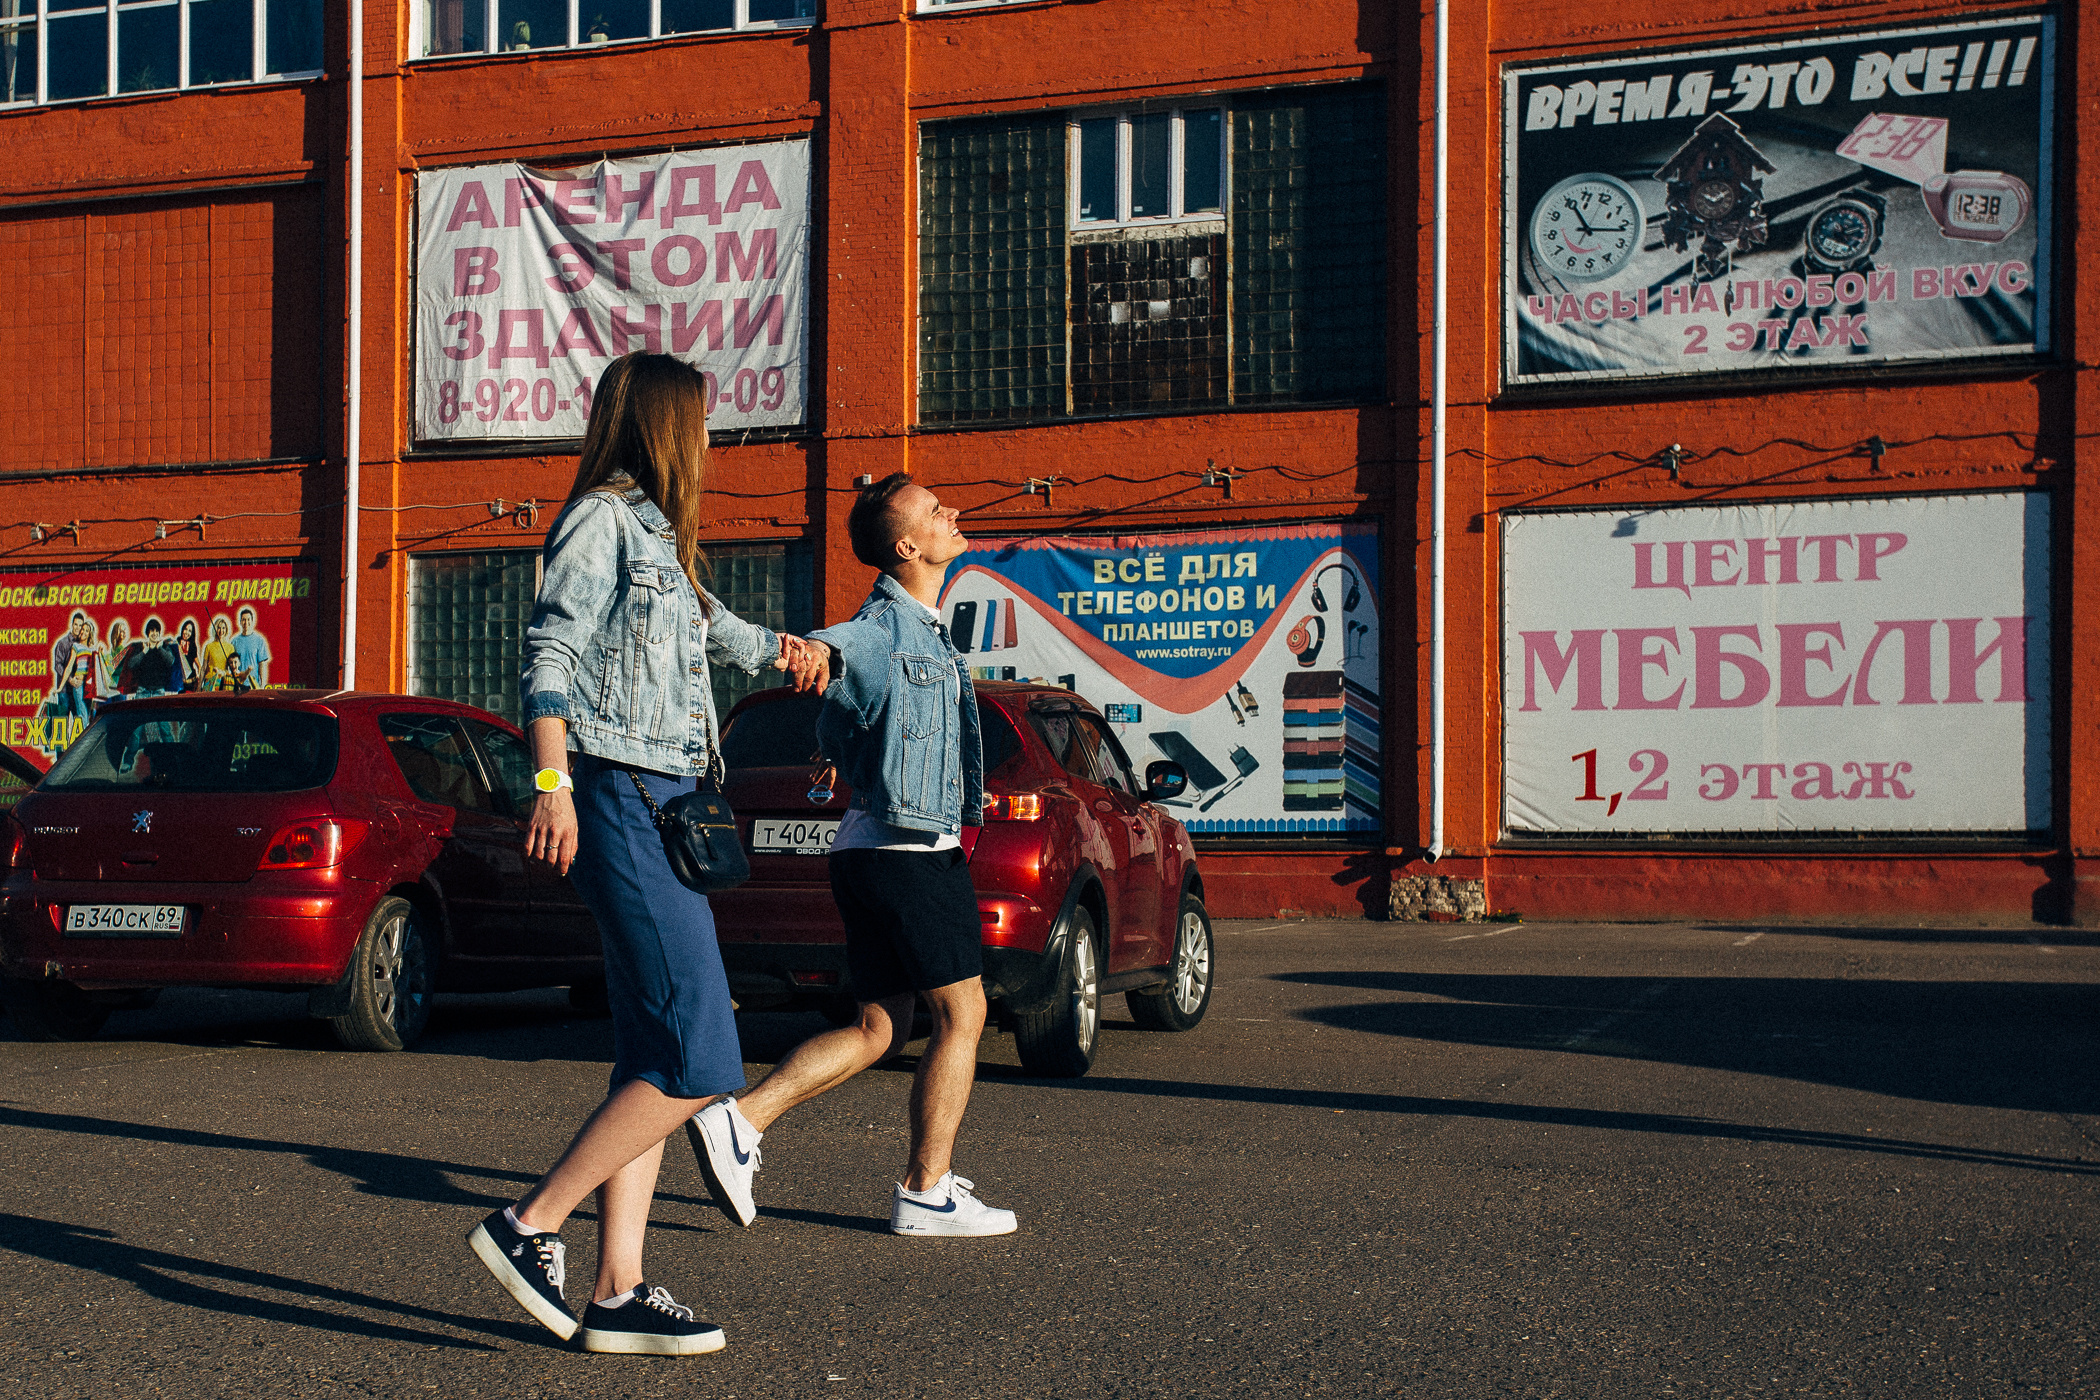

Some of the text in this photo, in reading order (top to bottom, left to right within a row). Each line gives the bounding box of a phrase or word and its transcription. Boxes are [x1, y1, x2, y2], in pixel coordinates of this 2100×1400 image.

[1525, 37, 2038, 132] ВРЕМЯ-ЭТО ВСЕ!!!
[445, 159, 782, 232] АРЕНДА
[1957, 194, 2001, 215] 12:38
[453, 228, 778, 297] В ЭТОМ
[1528, 261, 2029, 325] ЧАСЫ НА ЛЮБОЙ ВКУС
[442, 294, 784, 370] ЗДАНИИ
[1683, 314, 1869, 355] 2 ЭТАЖ
[1094, 552, 1257, 585] ВСЁ ДЛЯ
[1630, 532, 1908, 600] ЦЕНТР
[0, 577, 311, 608] осковская вещевая ярмарка
[1058, 584, 1276, 615] ТЕЛЕФОНОВ И
[1103, 619, 1255, 642] ПЛАНШЕТОВ
[1135, 645, 1231, 660] www.sotray.ru
[1518, 616, 2034, 713] МЕБЕЛИ
[1571, 748, 1915, 817] 1,2 этаж
[74, 907, 177, 928] В340СК 69
